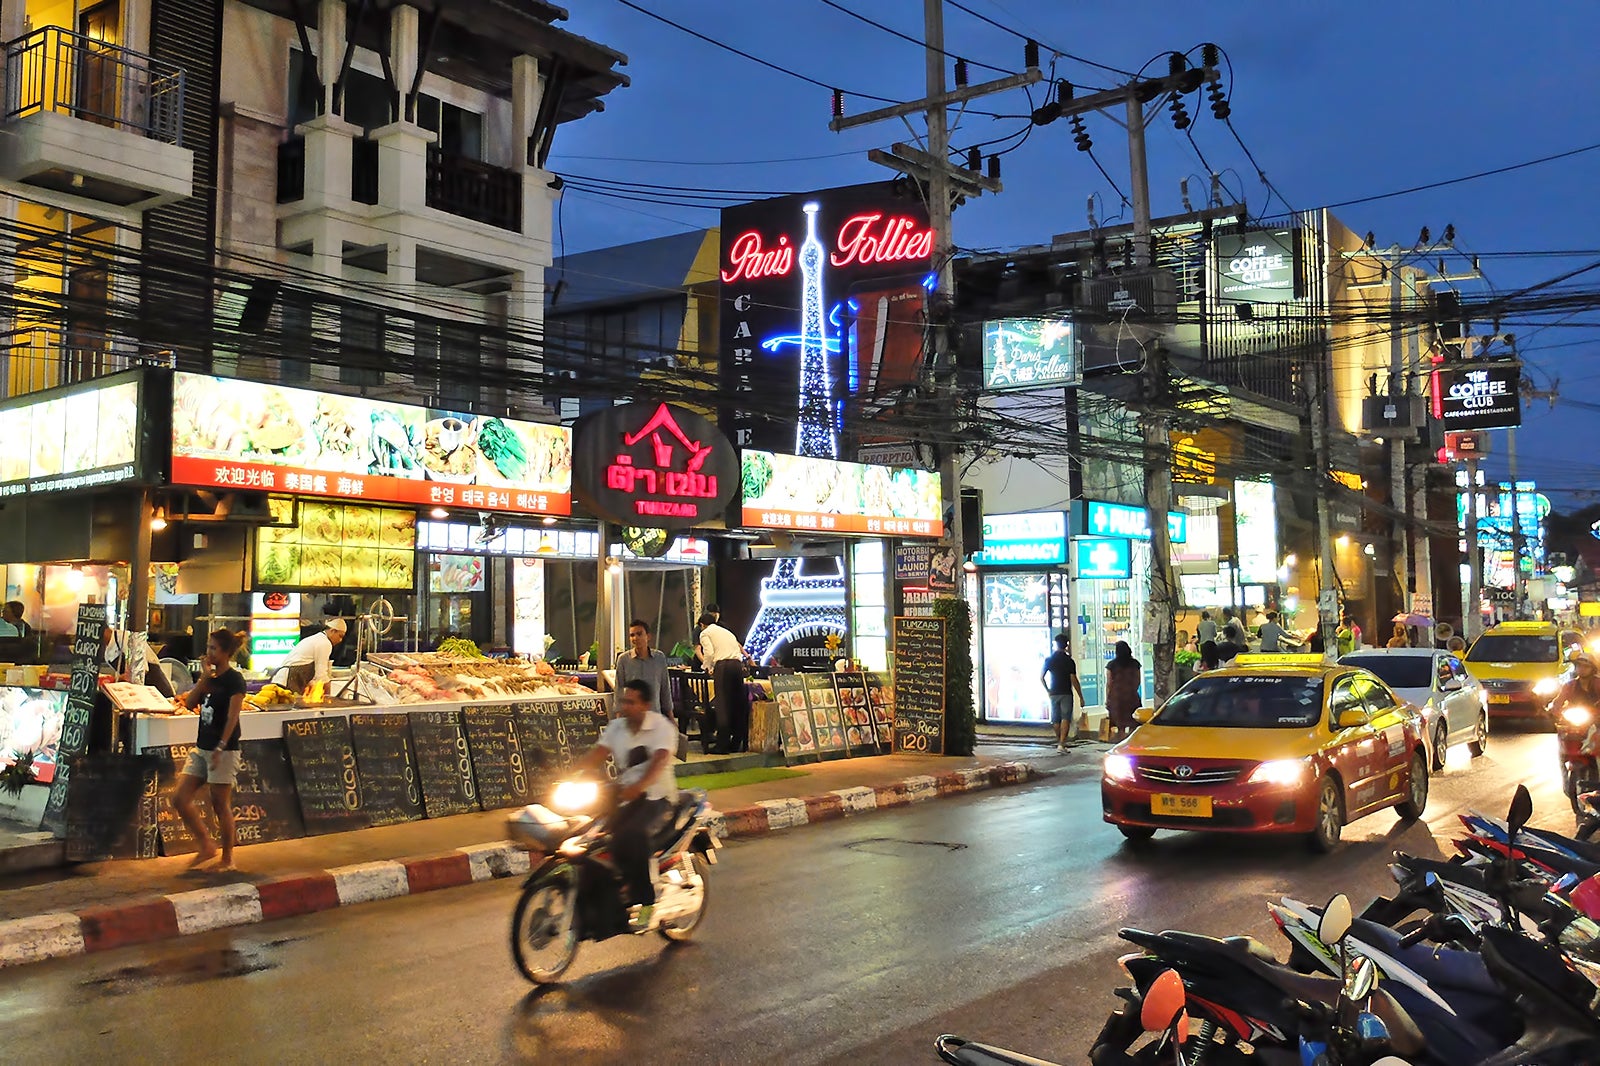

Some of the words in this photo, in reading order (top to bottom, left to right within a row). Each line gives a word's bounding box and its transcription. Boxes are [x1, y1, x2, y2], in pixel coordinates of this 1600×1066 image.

[721, 232, 793, 282] Paris
[831, 214, 934, 266] Follies
[1245, 246, 1266, 257] THE
[1230, 254, 1283, 273] COFFEE
[1242, 270, 1271, 284] CLUB
[1465, 370, 1488, 383] THE
[1449, 381, 1506, 397] COFFEE
[1463, 397, 1494, 409] CLUB
[215, 465, 275, 492] 欢迎光临
[285, 475, 327, 493] 泰国餐
[337, 476, 365, 496] 海鲜
[430, 486, 455, 504] 환영
[462, 488, 484, 507] 태국
[487, 491, 510, 509] 음식
[516, 493, 549, 512] 해산물
[78, 621, 101, 640] THAI
[902, 620, 939, 631] TUMZAAB
[786, 627, 819, 644] DRINK
[76, 639, 100, 657] CURRY
[794, 647, 809, 657] FREE
[72, 672, 90, 693] 120
[563, 699, 596, 711] SEAFOOD
[67, 702, 89, 727] PASTA
[62, 726, 81, 747] 160
[287, 720, 318, 737] MEAT
[917, 720, 938, 735] Rice
[903, 733, 927, 751] 120
[456, 727, 474, 799] 1990
[508, 720, 527, 794] 1490
